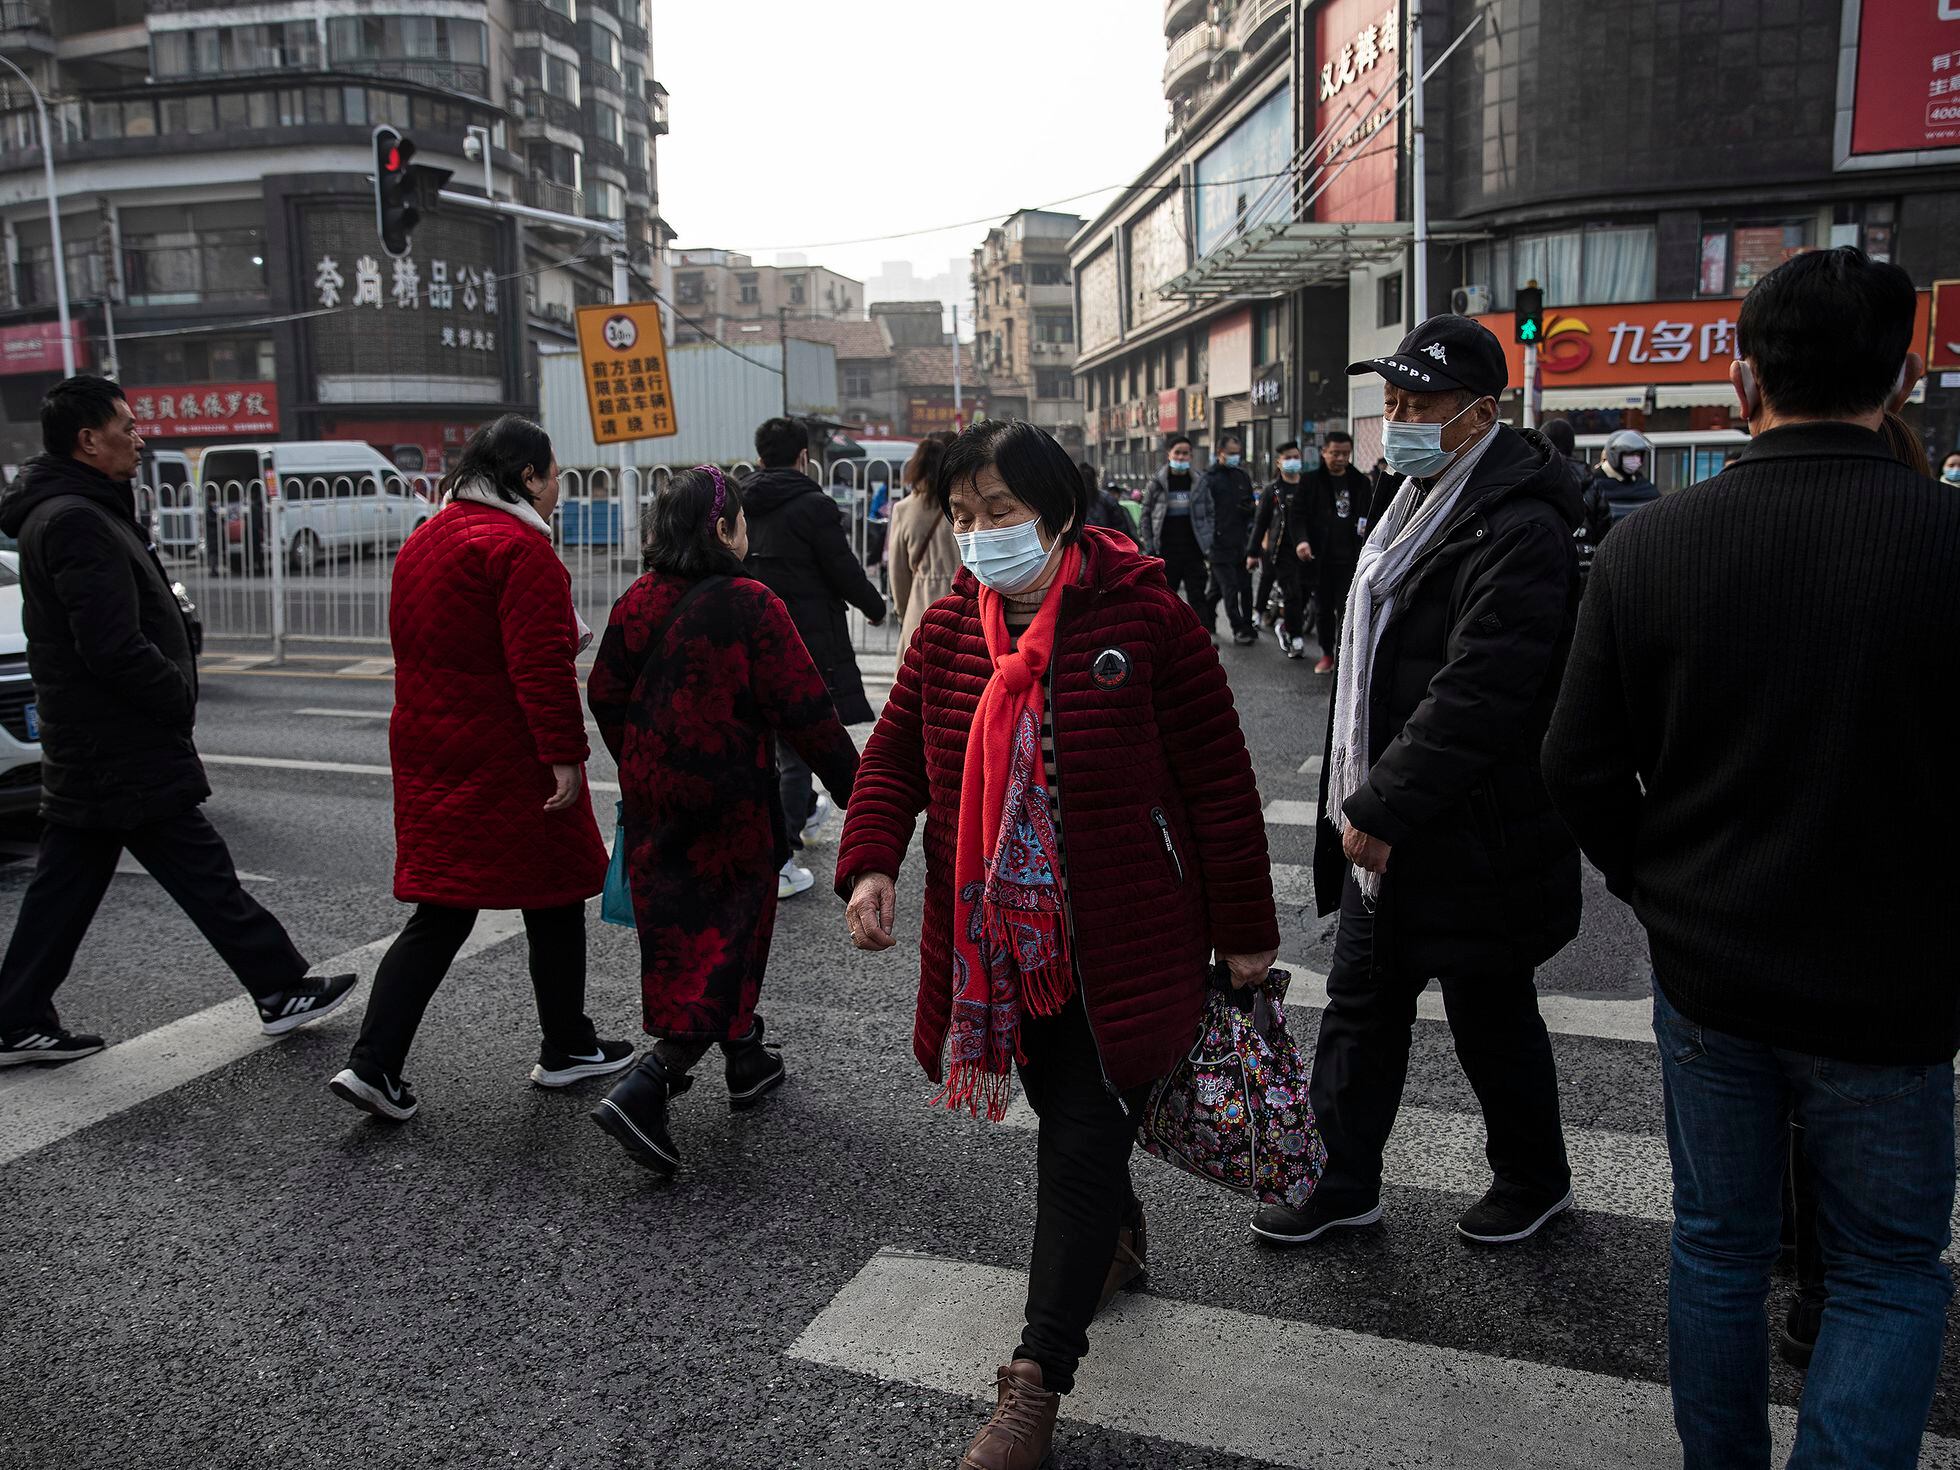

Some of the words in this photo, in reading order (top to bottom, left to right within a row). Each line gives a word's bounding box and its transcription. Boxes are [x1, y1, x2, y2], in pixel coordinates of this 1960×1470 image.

[1930, 106, 1960, 120] 400
[1607, 317, 1740, 364] 九多肉
[592, 356, 660, 378] 前方道路
[1373, 358, 1431, 382] Kappa
[595, 375, 663, 396] 限高通行
[599, 394, 667, 415] 超高车辆
[601, 412, 667, 435] 请绕行
